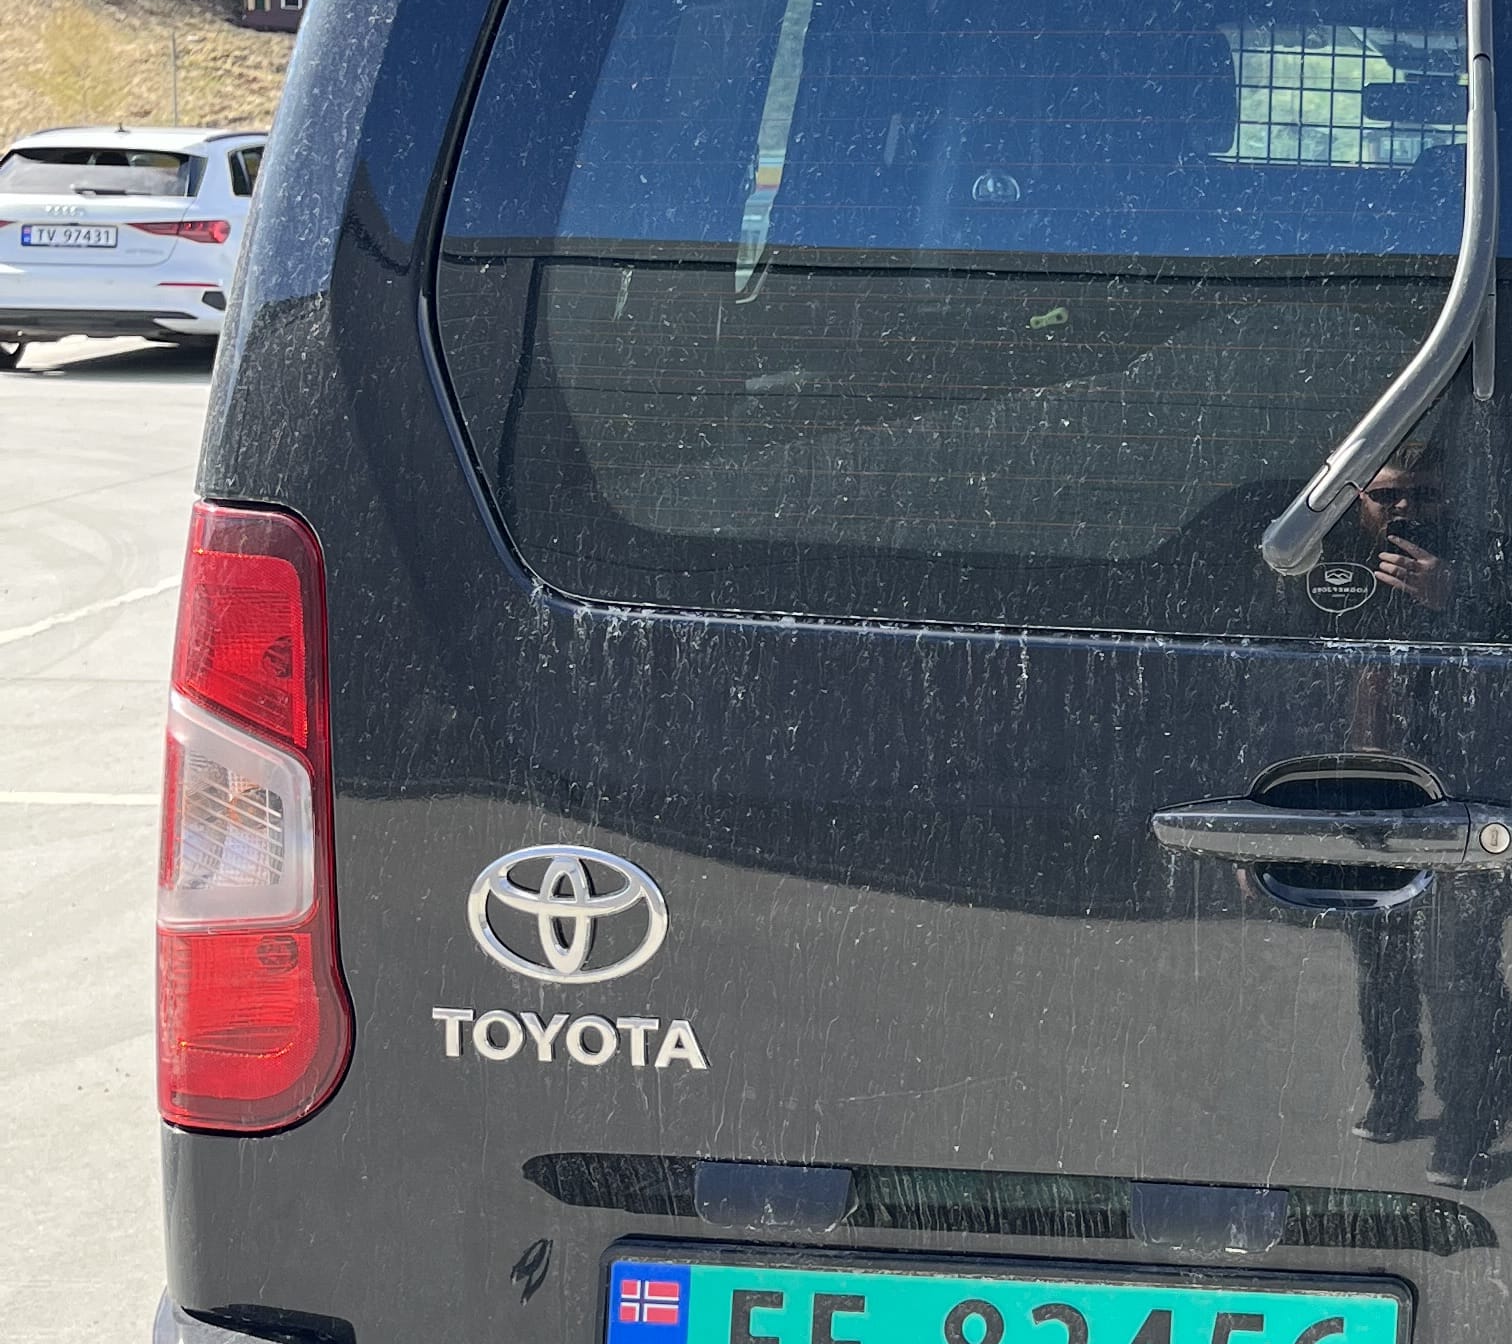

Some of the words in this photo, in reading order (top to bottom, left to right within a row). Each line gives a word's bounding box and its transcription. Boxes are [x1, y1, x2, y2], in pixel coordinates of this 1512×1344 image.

[37, 229, 57, 242] TV
[63, 230, 111, 244] 97431
[431, 1007, 710, 1070] TOYOTA
